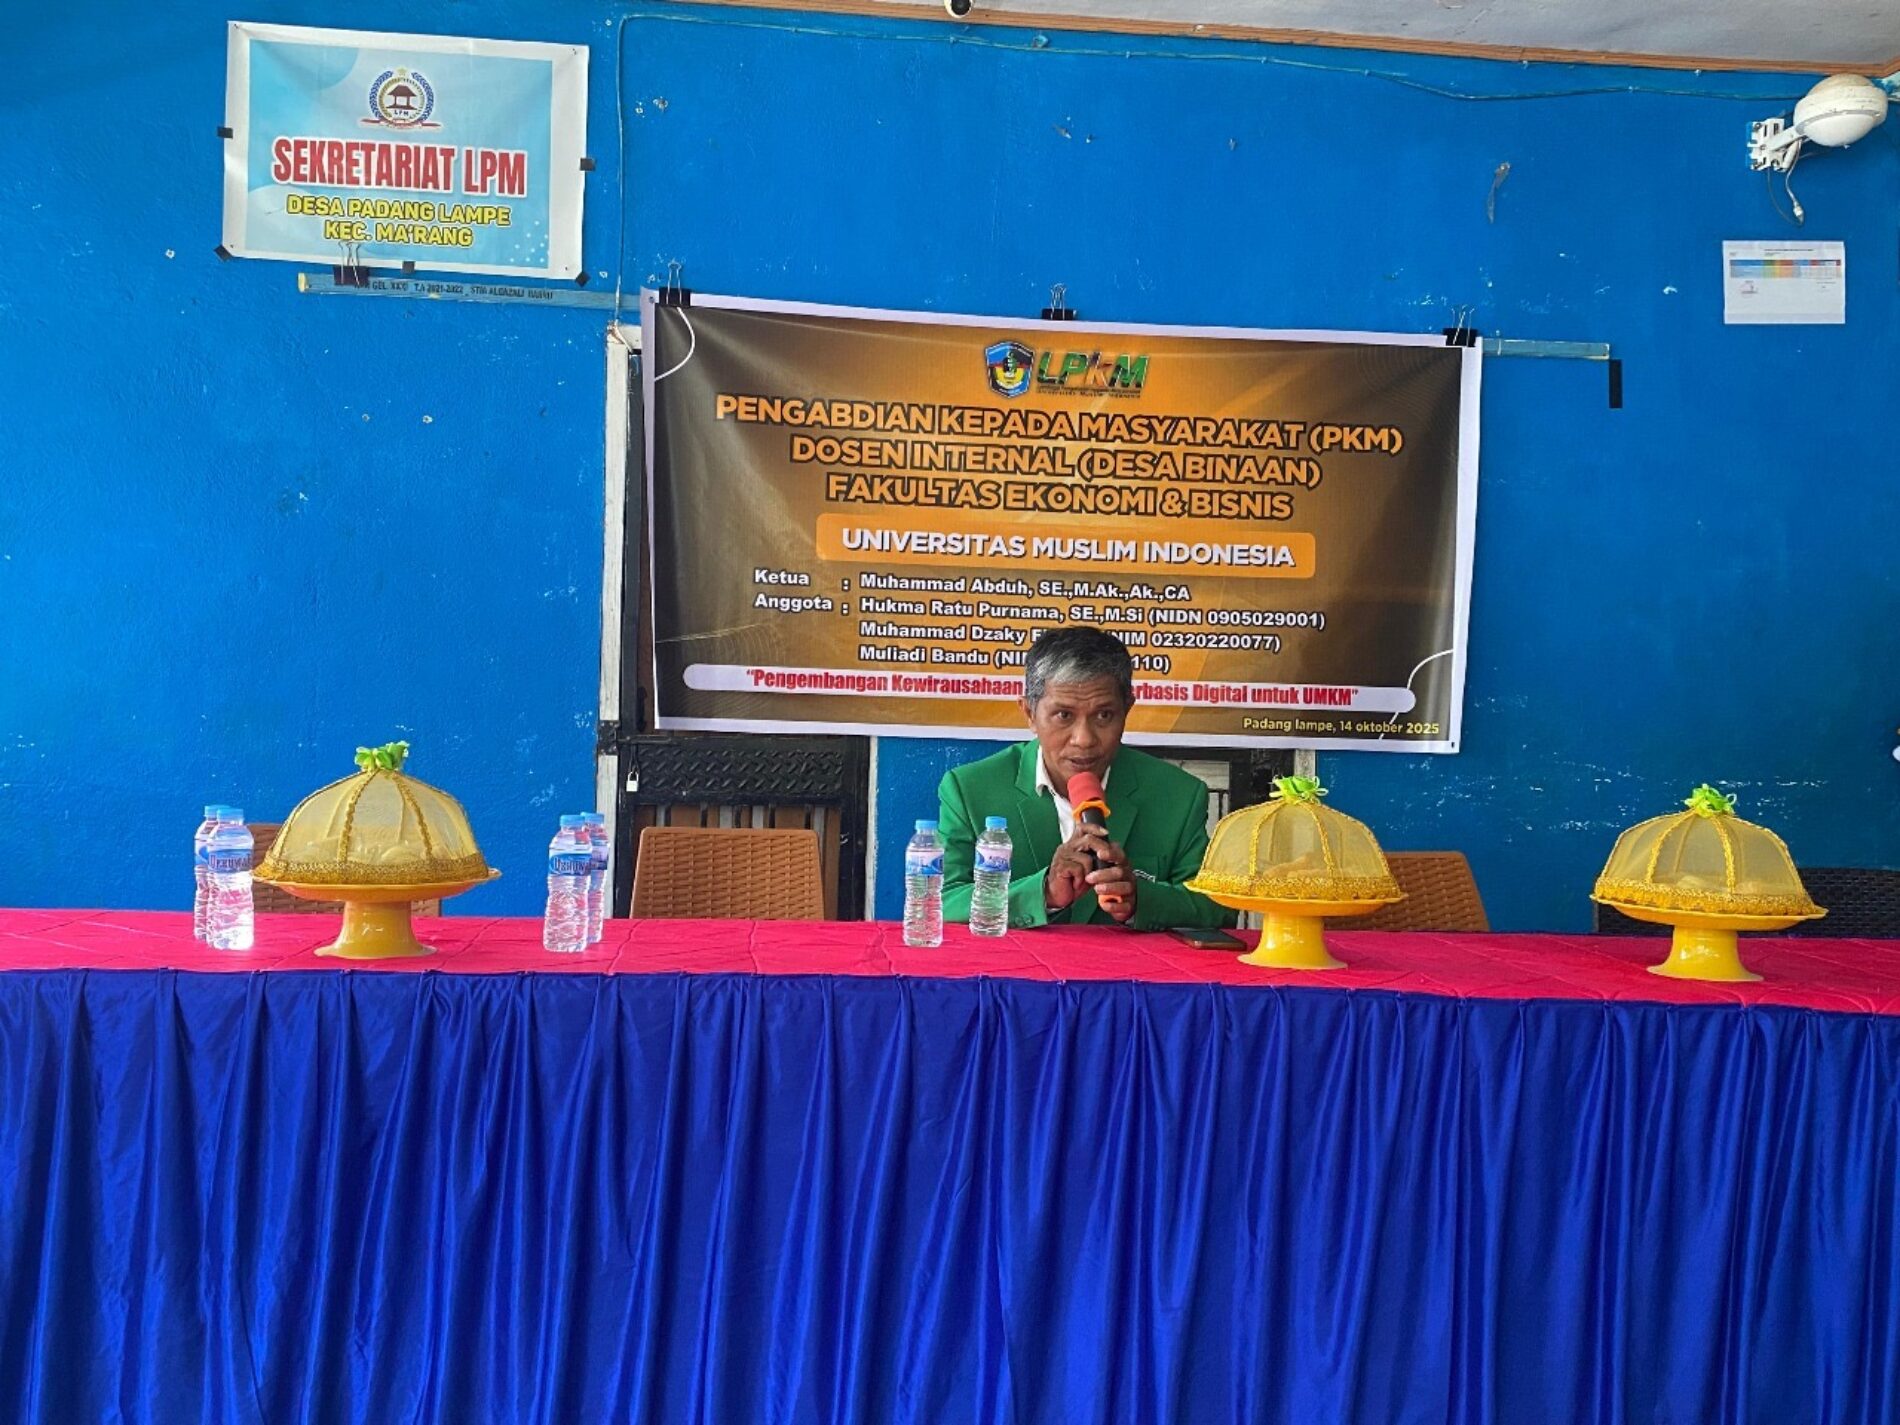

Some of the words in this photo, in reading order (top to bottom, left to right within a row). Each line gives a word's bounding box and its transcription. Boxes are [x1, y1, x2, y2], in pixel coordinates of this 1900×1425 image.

[273, 137, 456, 193] SEKRETARIAT
[463, 148, 526, 196] LPM
[287, 194, 345, 217] DESA
[347, 198, 435, 222] PADANG
[438, 203, 511, 226] LAMPE
[324, 219, 373, 241] KEC.
[715, 393, 934, 433] PENGABDIAN
[940, 407, 1075, 440] KEPADA
[1080, 412, 1304, 451] MASYARAKAT
[1309, 424, 1404, 458] (PKM)
[791, 434, 907, 469] DOSEN
[911, 441, 1074, 477] INTERNAL
[1077, 448, 1181, 482] (DESA
[1183, 455, 1322, 490] BINAAN)
[826, 472, 1000, 509] FAKULTAS
[1003, 482, 1155, 515] EKONOMI
[1160, 489, 1188, 516] &
[1189, 491, 1294, 519] BISNIS
[842, 528, 1026, 557] UNIVERSITAS
[1032, 537, 1137, 562] MUSLIM
[1143, 540, 1297, 567] INDONESIA
[753, 568, 811, 587] Ketua
[859, 573, 966, 593] Muhammad
[970, 577, 1034, 597] Abduh,
[1038, 580, 1191, 602] SE.,M.Ak.,Ak.,CA
[753, 592, 833, 613] Anggota
[860, 596, 926, 615] Hukma
[930, 600, 973, 617] Ratu
[978, 601, 1065, 623] Purnama,
[1069, 606, 1144, 625] SE.,M.Si
[1148, 609, 1202, 628] (NIDN
[1207, 611, 1326, 632] 0905029001)
[859, 621, 966, 641] Muhammad
[971, 625, 1027, 646] Dzaky
[1151, 632, 1282, 653] 02320220077)
[858, 644, 926, 663] Muliadi
[931, 647, 989, 666] Bandu
[891, 674, 1024, 696] Kewirausahaan
[1192, 683, 1248, 703] Digital
[1251, 685, 1301, 703] untuk
[1243, 717, 1292, 734] Padang
[1295, 718, 1337, 734] lampe,
[1340, 719, 1353, 732] 14
[1355, 720, 1403, 734] oktober
[1406, 722, 1440, 735] 2025
